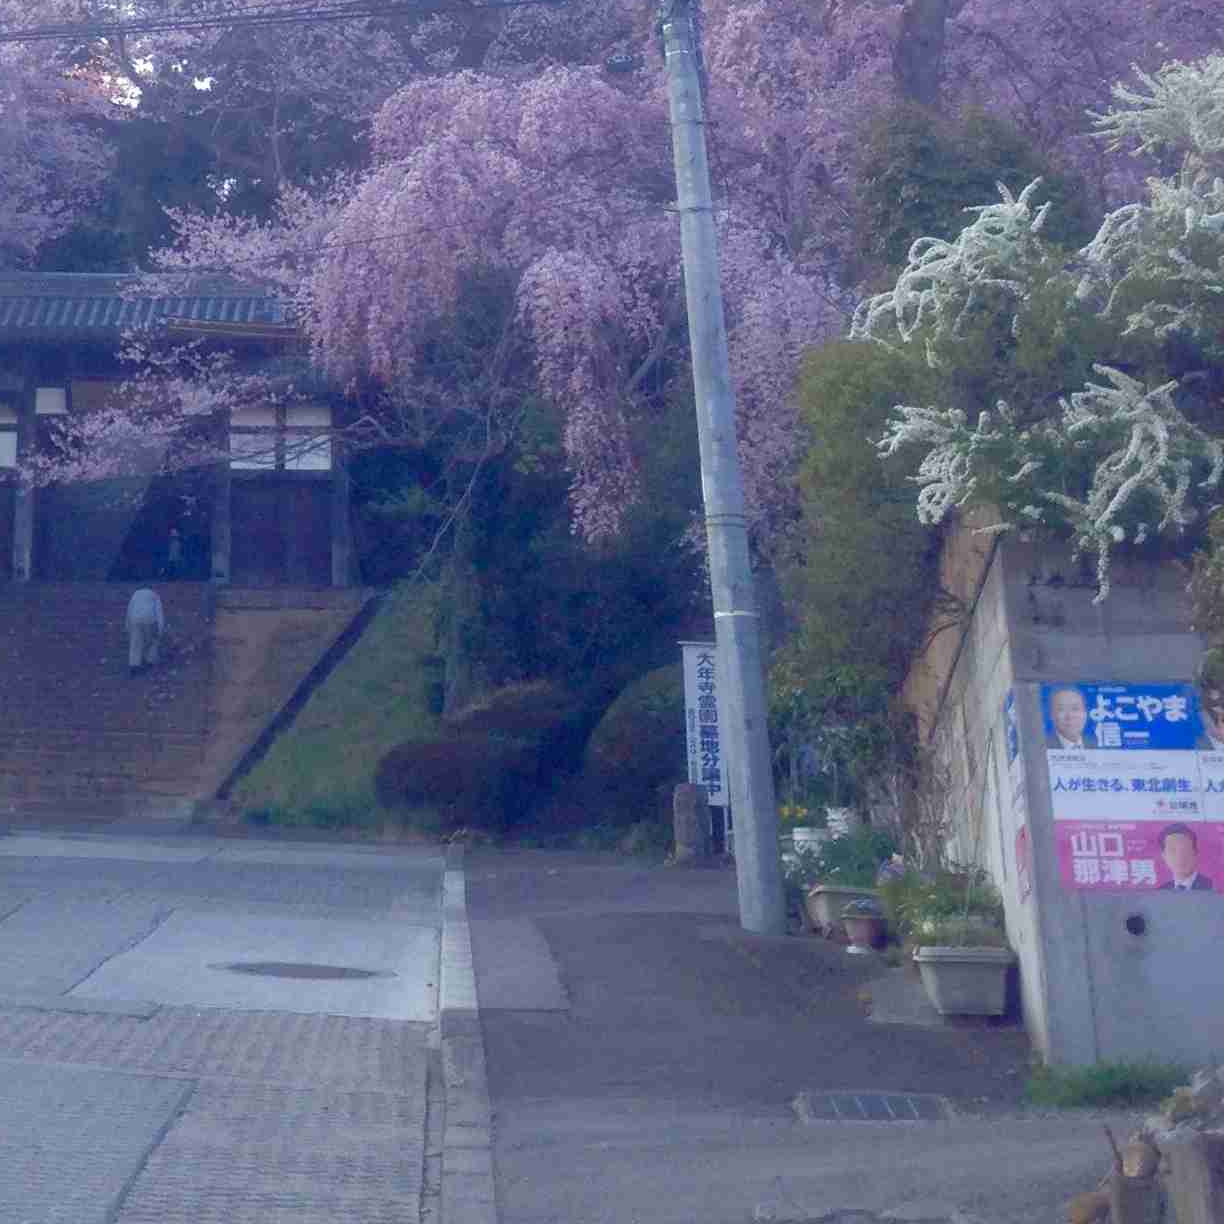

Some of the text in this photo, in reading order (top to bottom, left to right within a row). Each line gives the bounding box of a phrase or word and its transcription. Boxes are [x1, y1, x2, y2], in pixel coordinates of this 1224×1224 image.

[1090, 695, 1188, 722] よこやま
[1095, 722, 1150, 747] 信一
[1070, 832, 1125, 858] 山口
[1073, 858, 1158, 885] 那津男
